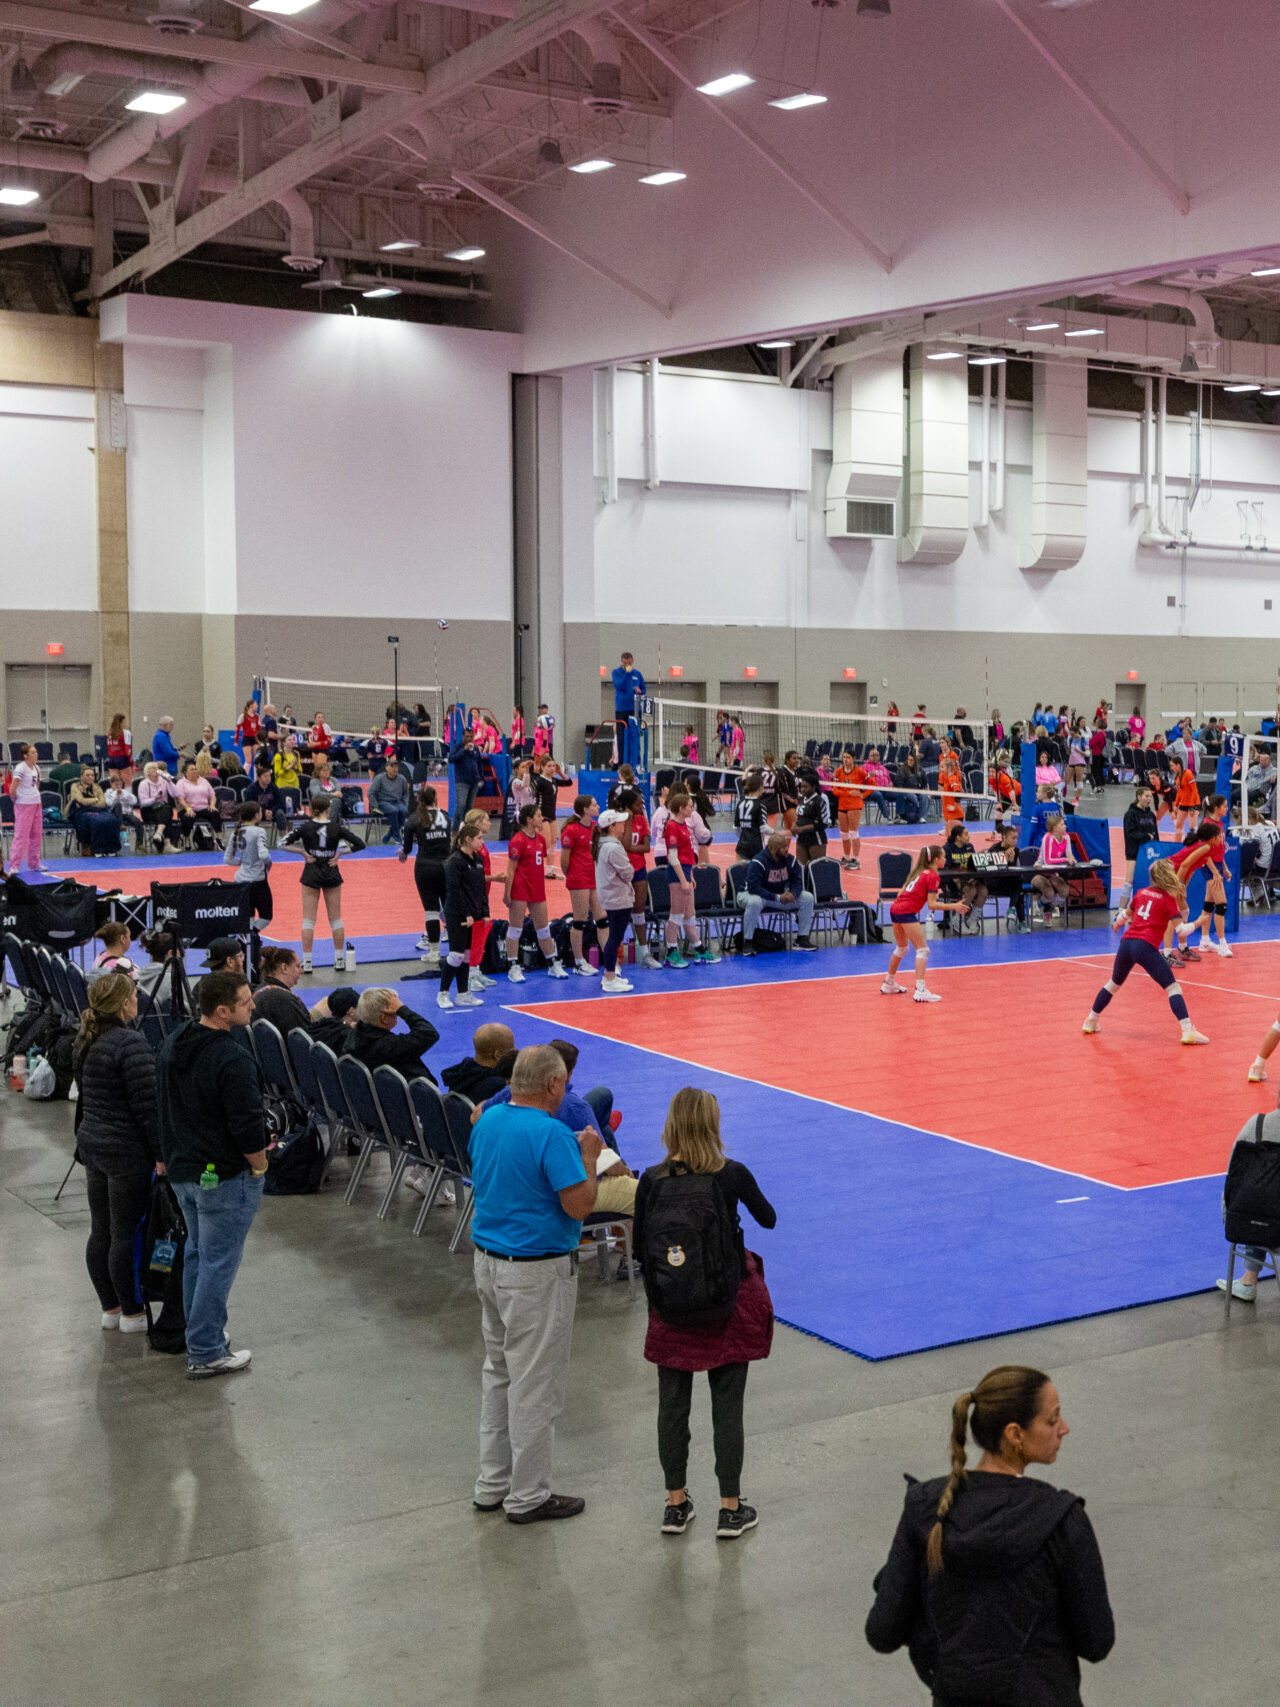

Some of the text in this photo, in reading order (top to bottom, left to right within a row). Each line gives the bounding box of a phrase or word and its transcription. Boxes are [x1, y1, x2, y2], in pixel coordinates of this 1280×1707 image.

[644, 698, 652, 714] 8
[1229, 737, 1239, 755] 9
[738, 800, 754, 820] 12
[238, 829, 247, 850] 5
[316, 825, 327, 848] 1
[535, 851, 543, 865] 6
[195, 906, 239, 919] molten
[1137, 900, 1153, 921] 4
